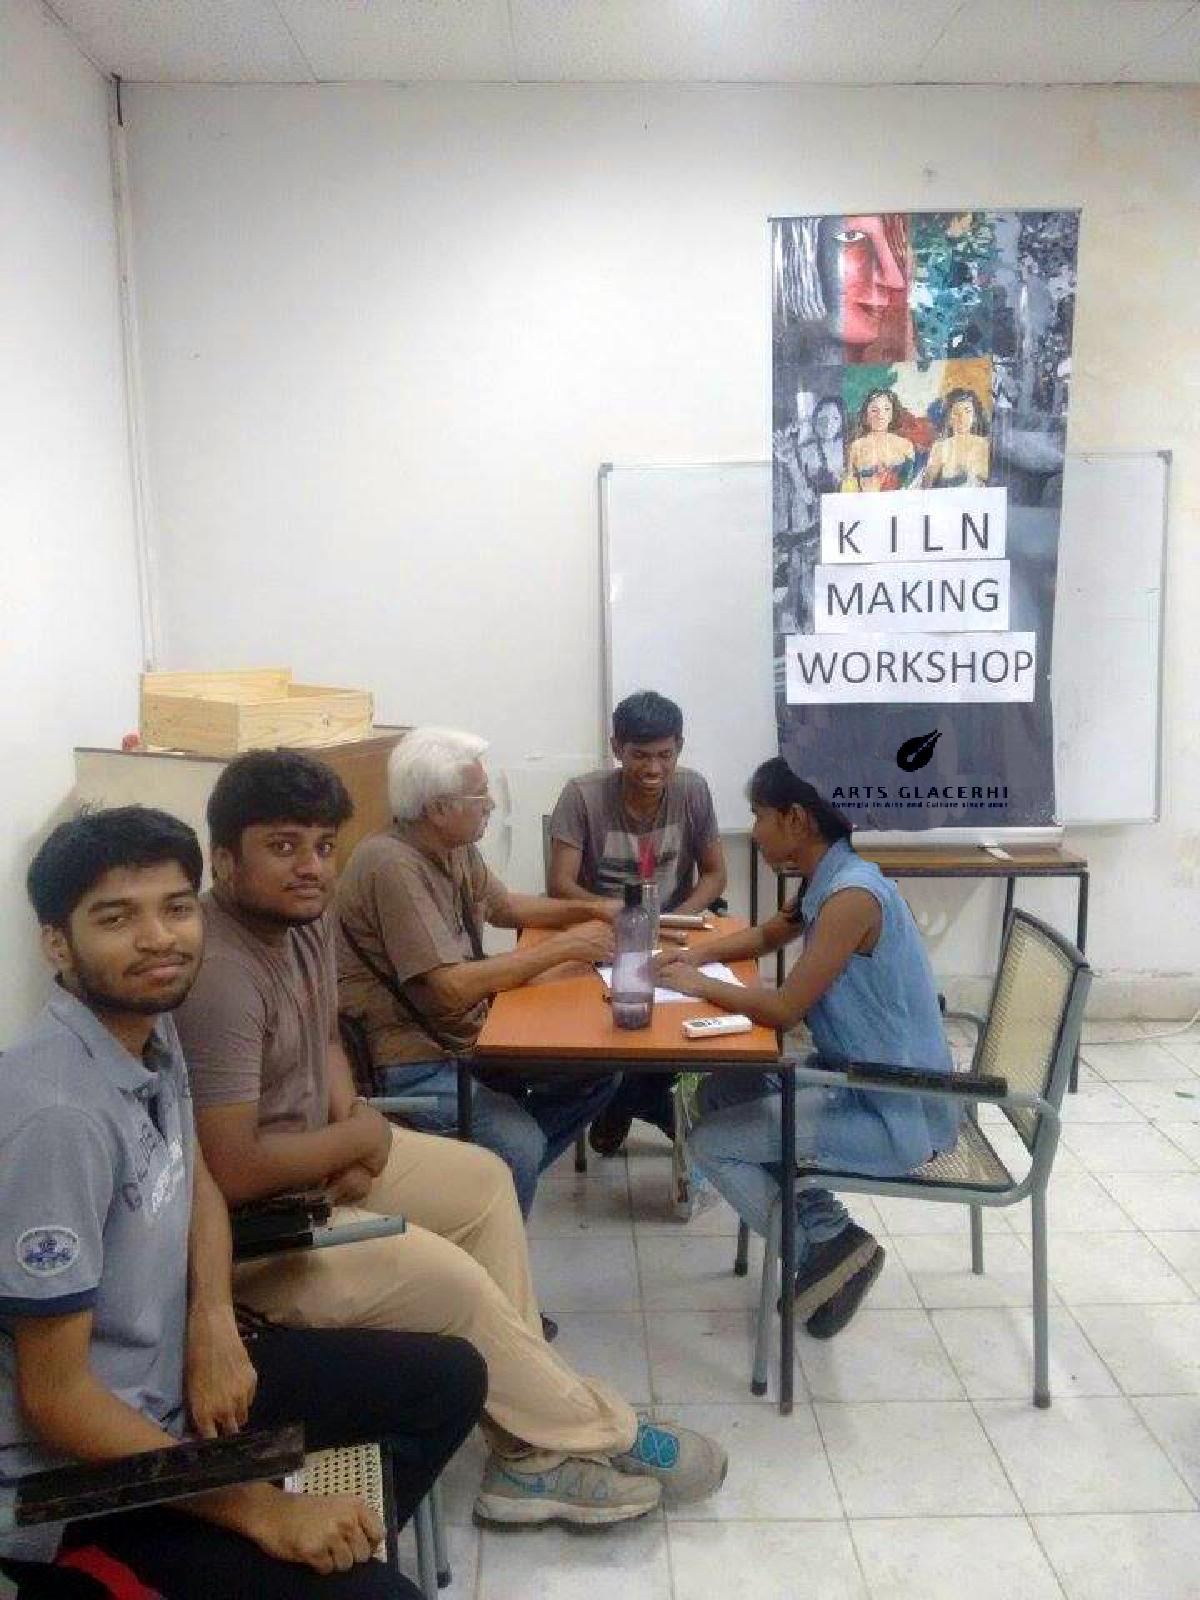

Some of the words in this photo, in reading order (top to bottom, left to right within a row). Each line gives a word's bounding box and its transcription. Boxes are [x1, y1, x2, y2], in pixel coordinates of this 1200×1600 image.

[838, 512, 990, 554] KILN
[827, 578, 999, 616] MAKING
[797, 650, 1034, 684] WORKSHOP
[832, 786, 888, 799] ARTS
[898, 786, 1008, 799] GLACERHI
